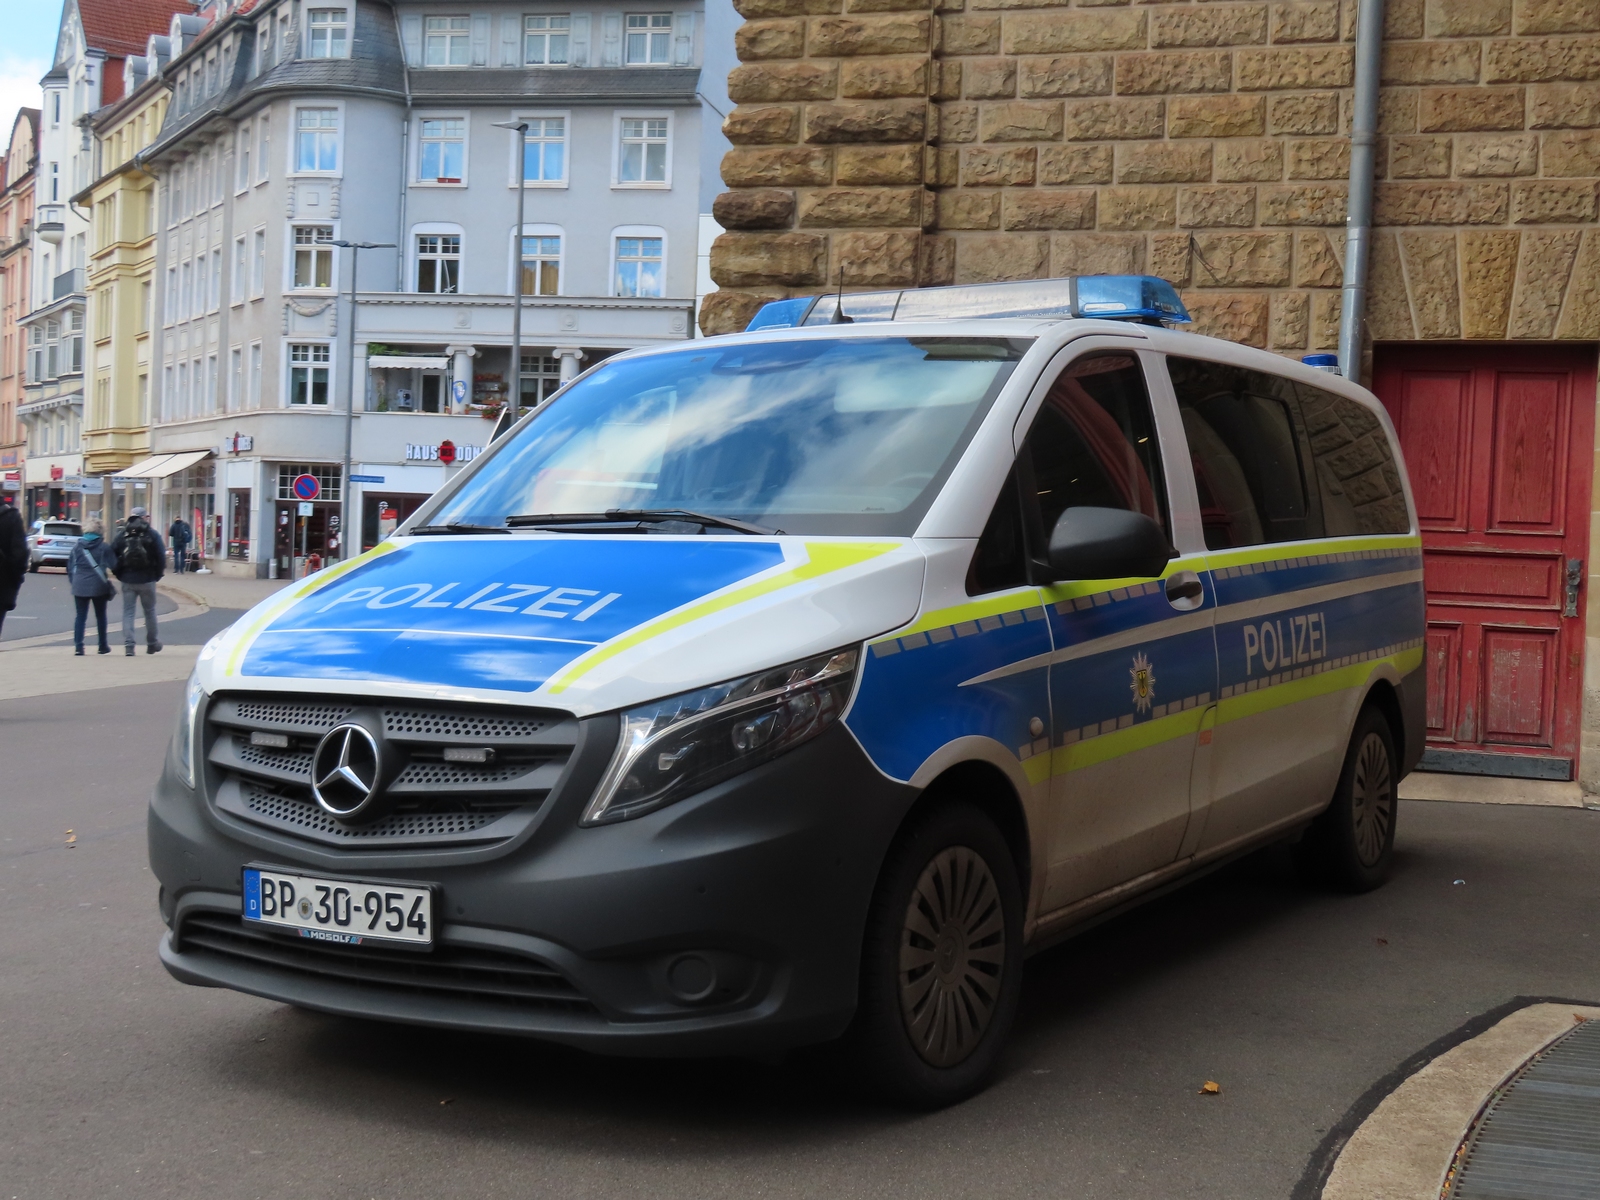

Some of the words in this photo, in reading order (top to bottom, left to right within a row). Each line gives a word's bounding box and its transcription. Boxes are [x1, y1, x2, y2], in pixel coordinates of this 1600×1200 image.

[406, 444, 437, 460] HAUS
[315, 582, 623, 622] POLIZEI
[1243, 612, 1327, 676] POLIZEI
[250, 899, 256, 911] D
[261, 878, 295, 918] BP
[315, 885, 426, 935] 30-954
[310, 930, 351, 943] MOSOLF
